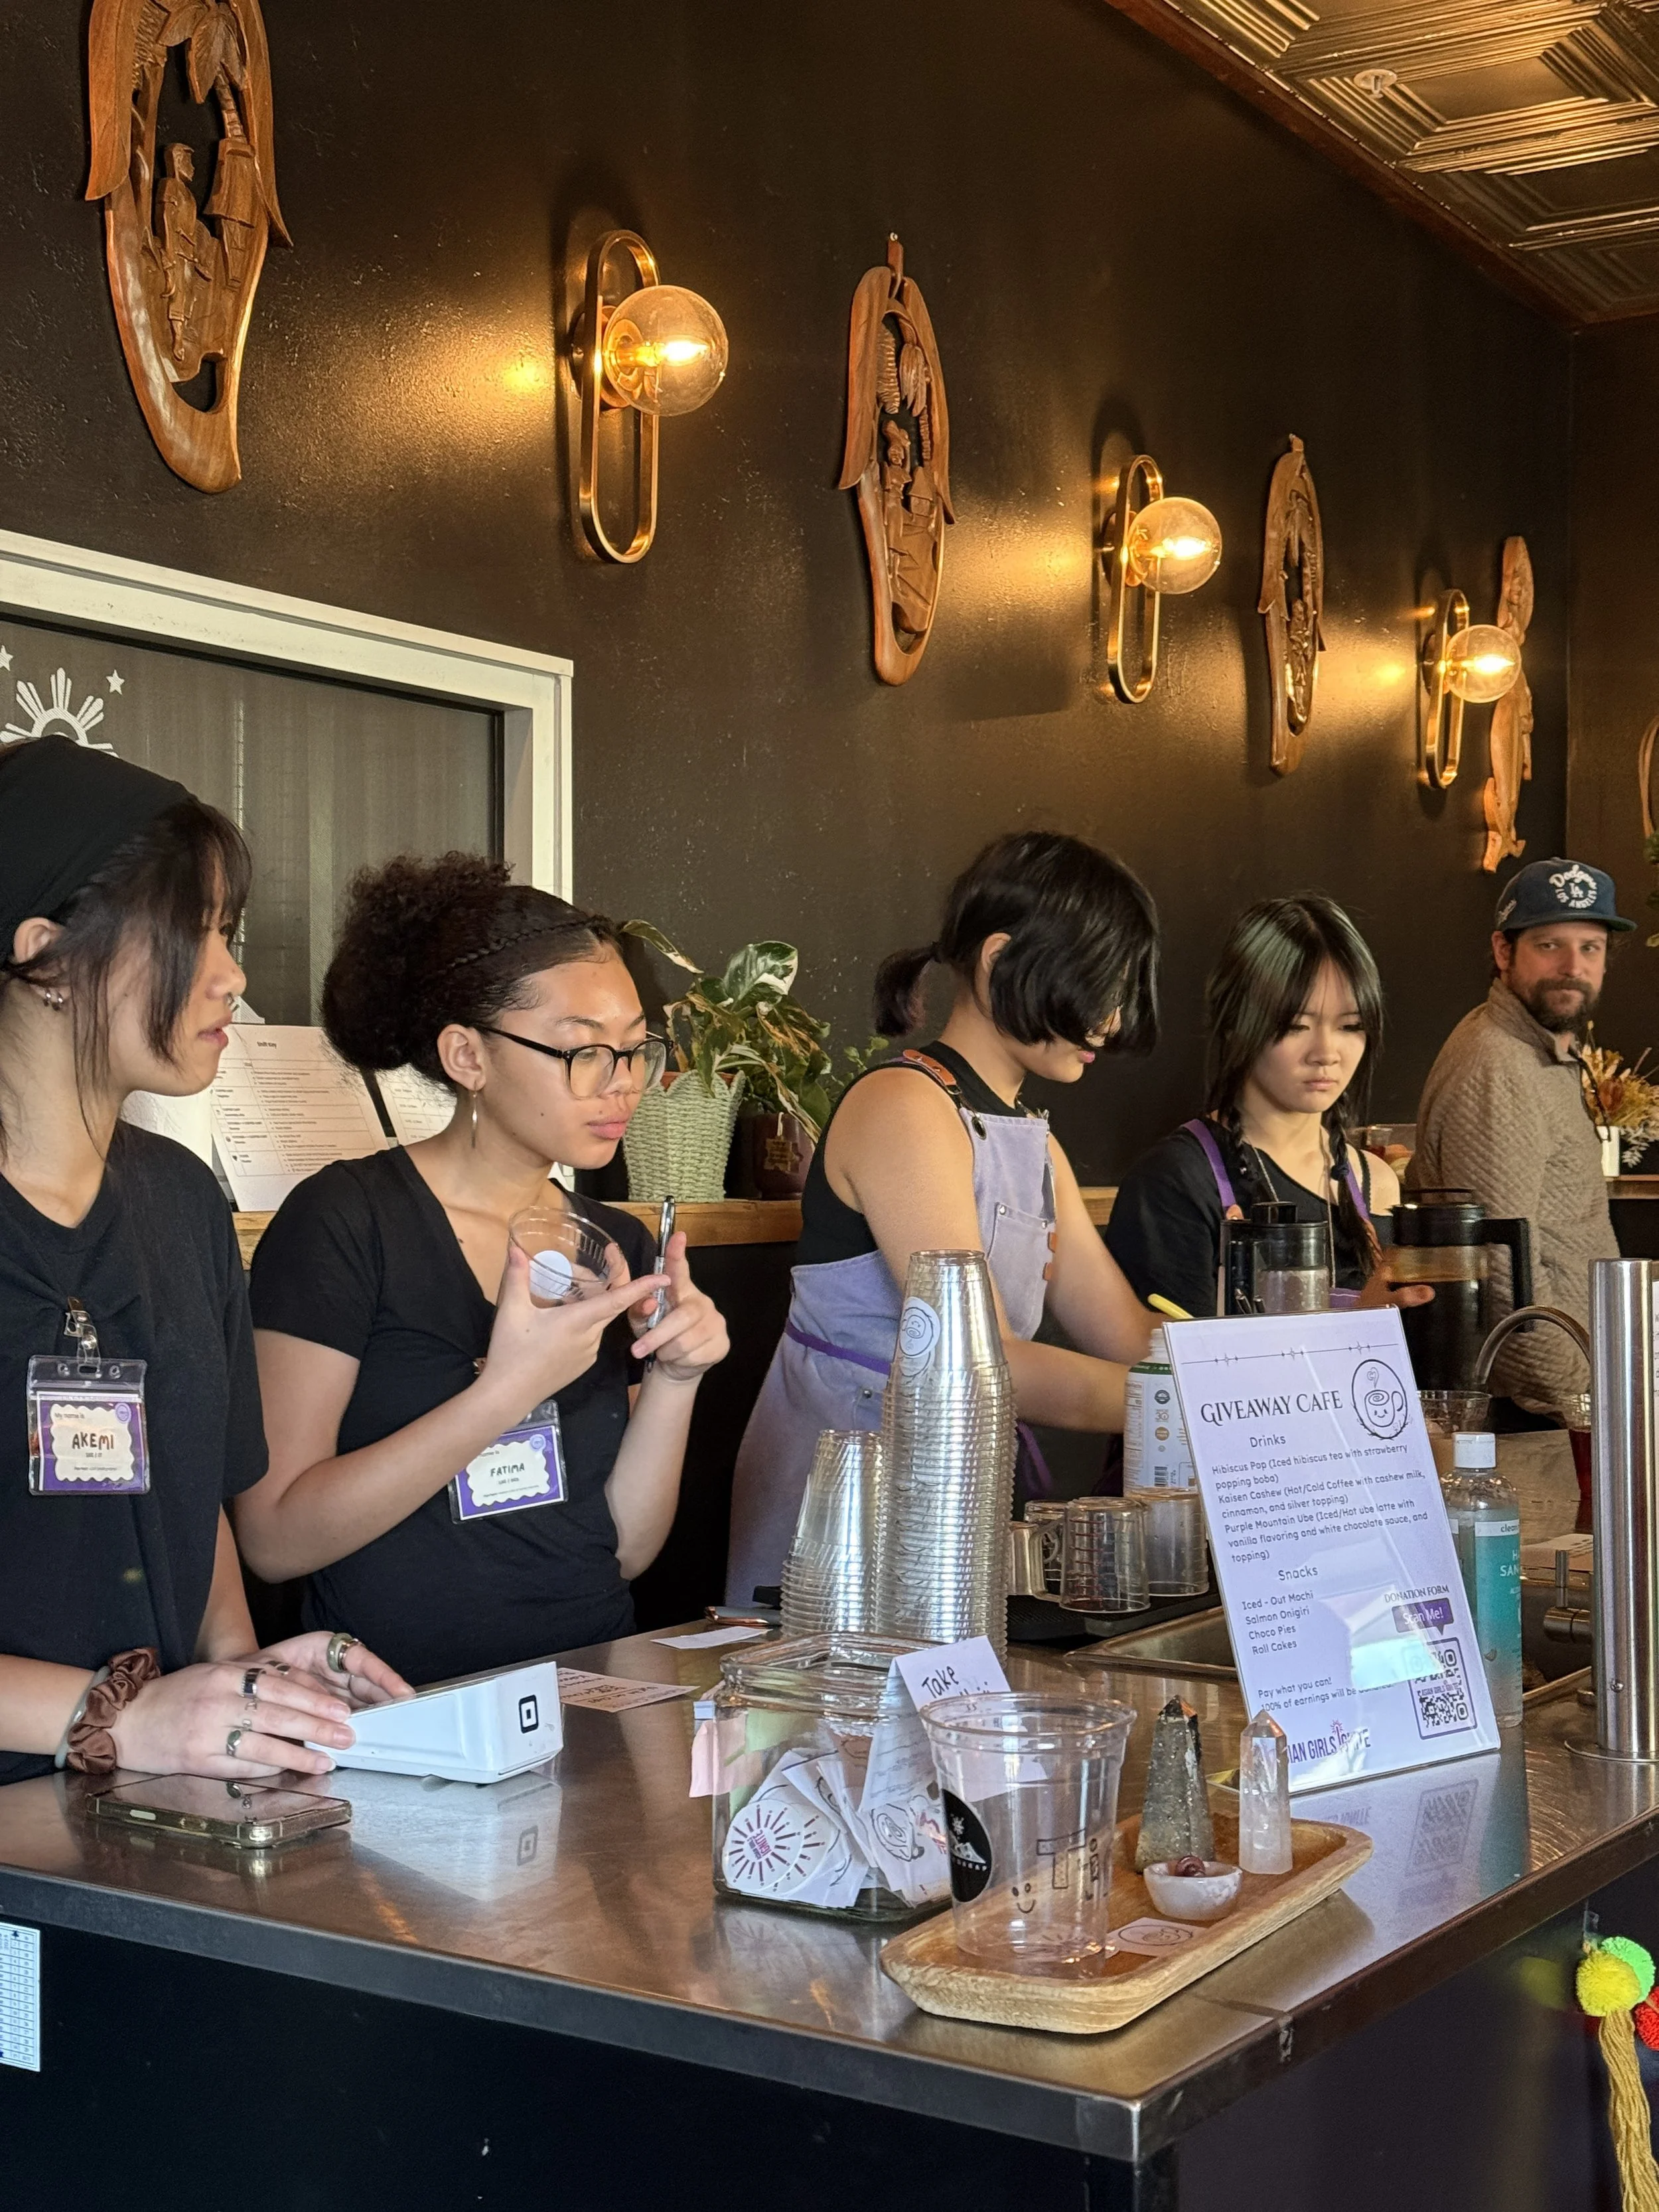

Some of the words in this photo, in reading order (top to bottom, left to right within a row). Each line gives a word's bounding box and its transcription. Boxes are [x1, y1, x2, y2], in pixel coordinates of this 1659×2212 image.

[1549, 864, 1597, 890] Dodgers
[1569, 883, 1584, 898] LA
[1200, 1396, 1291, 1426] GIVEAWAY
[1296, 1390, 1343, 1412] CAFE
[72, 1432, 114, 1450] AKEMI
[1250, 1434, 1286, 1447] Drinks
[490, 1463, 525, 1477] FATIMA
[1212, 1463, 1249, 1475] Hibiscus
[1250, 1461, 1267, 1471] Pop
[1269, 1457, 1291, 1469] (Iced
[1293, 1453, 1328, 1465] hibiscus
[1329, 1451, 1343, 1460] tea
[1344, 1449, 1362, 1458] with
[1364, 1445, 1407, 1457] strawberry
[1215, 1477, 1252, 1491] popping
[1253, 1473, 1279, 1485] boba)
[1218, 1493, 1248, 1504] Kaisen
[1250, 1489, 1281, 1500] Cashew
[1284, 1482, 1325, 1497] (Hot/Cold
[1327, 1479, 1354, 1490] Coffee
[1355, 1477, 1373, 1486] with
[1375, 1473, 1404, 1483] cashew
[1406, 1469, 1425, 1479] milk,
[1222, 1506, 1267, 1518] cinnamon,
[1269, 1503, 1285, 1512] and
[1287, 1500, 1310, 1510] silver
[1312, 1494, 1348, 1507] topping)
[1224, 1521, 1253, 1534] Purple
[1255, 1515, 1295, 1529] Mountain
[1297, 1513, 1314, 1523] Ube
[1316, 1508, 1357, 1522] (Iced/Hot
[1359, 1505, 1374, 1514] ube
[1376, 1503, 1396, 1512] latte
[1398, 1499, 1415, 1509] with
[1228, 1535, 1258, 1548] vanilla
[1260, 1530, 1299, 1543] flavoring
[1301, 1527, 1317, 1537] and
[1319, 1524, 1341, 1534] white
[1343, 1518, 1383, 1532] chocolate
[1385, 1514, 1411, 1524] sauce,
[1412, 1511, 1428, 1521] and
[1232, 1550, 1270, 1563] topping)
[1278, 1566, 1319, 1581] Snacks
[1242, 1598, 1262, 1610] Iced
[1270, 1595, 1286, 1605] Out
[1288, 1590, 1314, 1603] Mochi
[1384, 1587, 1427, 1603] DONATION
[1427, 1585, 1450, 1596] FORM
[1245, 1613, 1278, 1625] Salmon
[1279, 1605, 1310, 1619] Onigiri
[1403, 1612, 1425, 1625] Scan
[1426, 1607, 1443, 1621] Me!
[1248, 1629, 1276, 1640] Choco
[1277, 1625, 1296, 1635] Pies
[1252, 1643, 1269, 1655] Roll
[1271, 1641, 1297, 1652] Cakes
[921, 1666, 959, 1698] Take
[1258, 1689, 1274, 1699] Pay
[1275, 1684, 1296, 1694] what
[1299, 1682, 1313, 1693] you
[1315, 1676, 1332, 1687] can!
[1283, 1698, 1292, 1708] of
[1294, 1692, 1329, 1706] earnings
[1331, 1688, 1345, 1698] will
[1346, 1688, 1357, 1696] be
[1288, 1741, 1307, 1764] IAN
[1308, 1735, 1337, 1761] GIRLS
